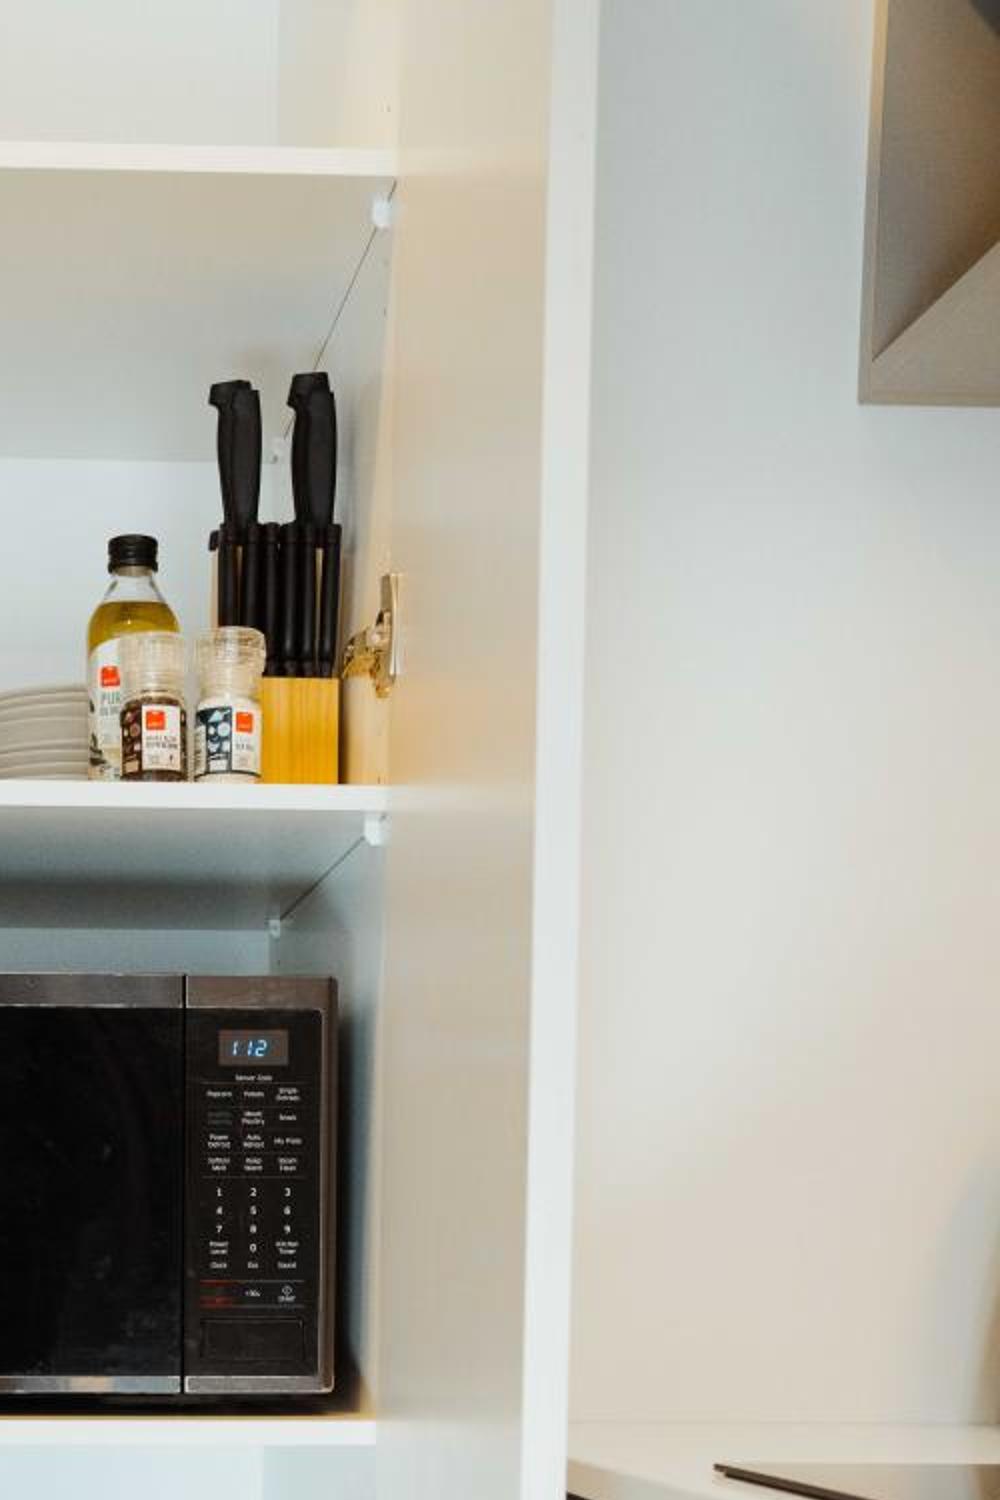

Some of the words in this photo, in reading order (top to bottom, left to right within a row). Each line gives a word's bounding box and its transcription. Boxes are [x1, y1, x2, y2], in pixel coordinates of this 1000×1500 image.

[216, 1187, 223, 1197] 1
[249, 1187, 257, 1197] 2
[216, 1224, 223, 1234] 7
